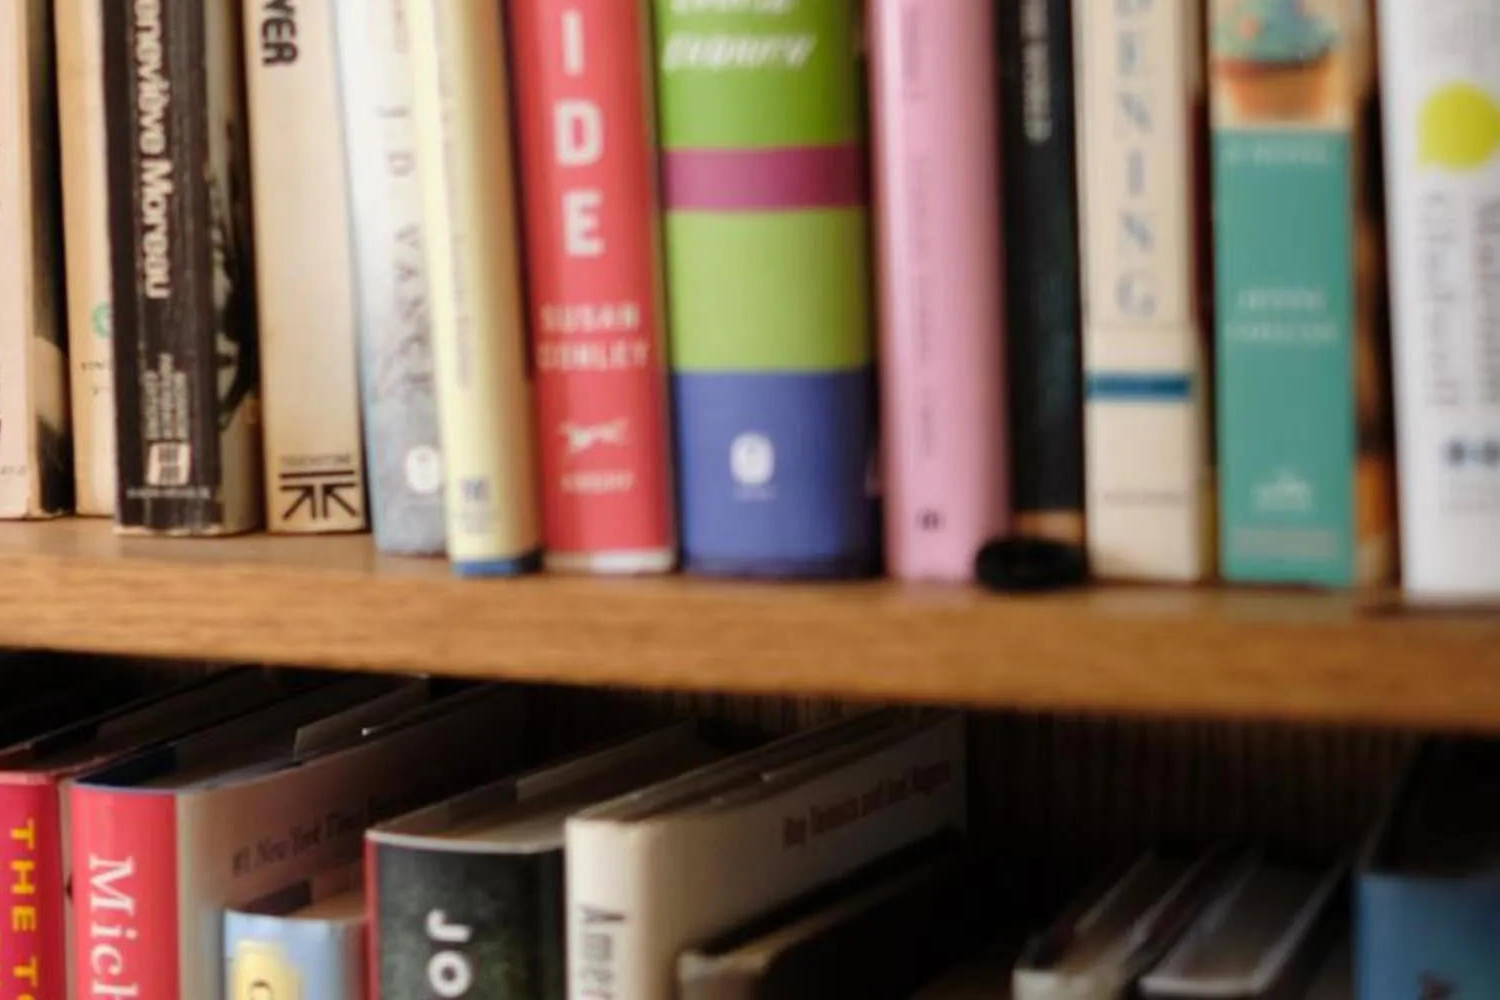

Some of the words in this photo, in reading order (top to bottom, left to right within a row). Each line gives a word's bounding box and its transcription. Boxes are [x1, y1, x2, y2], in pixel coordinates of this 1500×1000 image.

[139, 159, 174, 299] Moreau
[540, 301, 640, 334] SUSAN
[536, 338, 650, 372] CONLEY
[9, 818, 37, 933] THE
